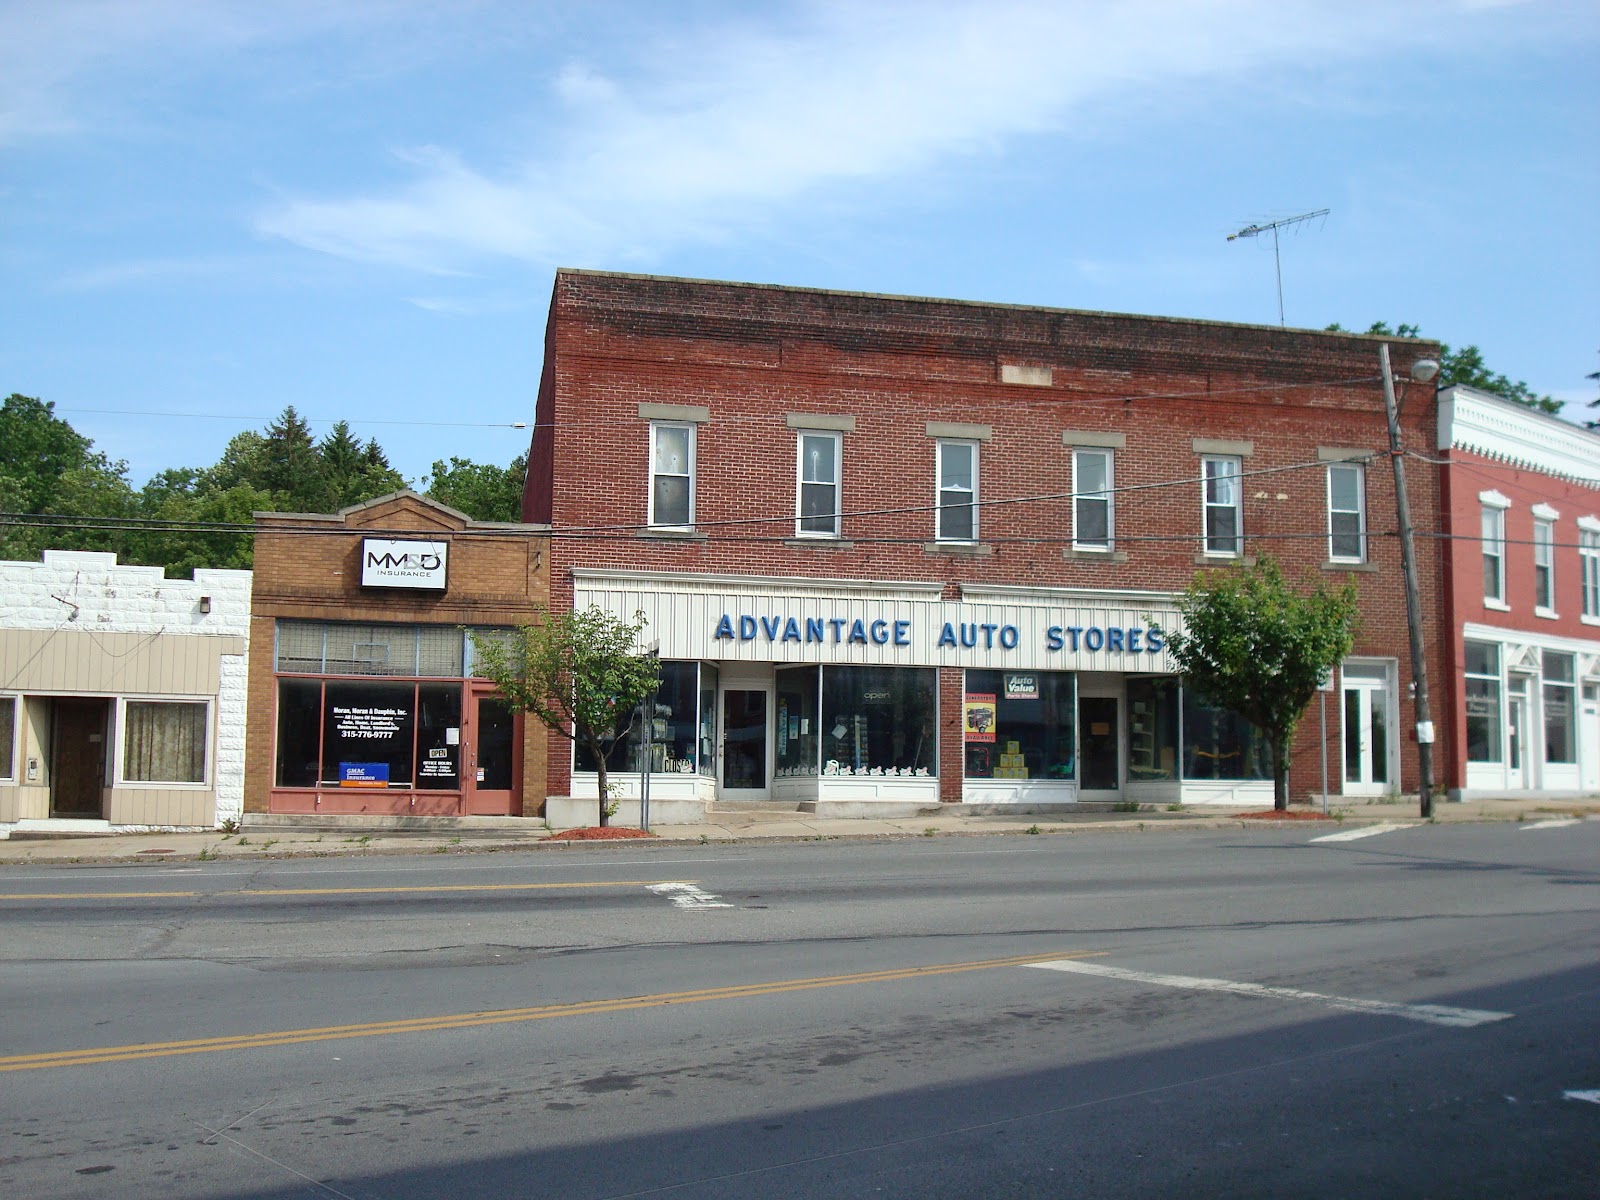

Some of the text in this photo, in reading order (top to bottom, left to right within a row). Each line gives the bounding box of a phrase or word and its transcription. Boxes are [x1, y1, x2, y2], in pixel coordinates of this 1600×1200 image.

[715, 613, 1164, 652] ADVANTAGE AUTO STORES
[1010, 676, 1033, 684] Auto
[1008, 684, 1035, 692] Value
[341, 730, 393, 738] 315-776-9777
